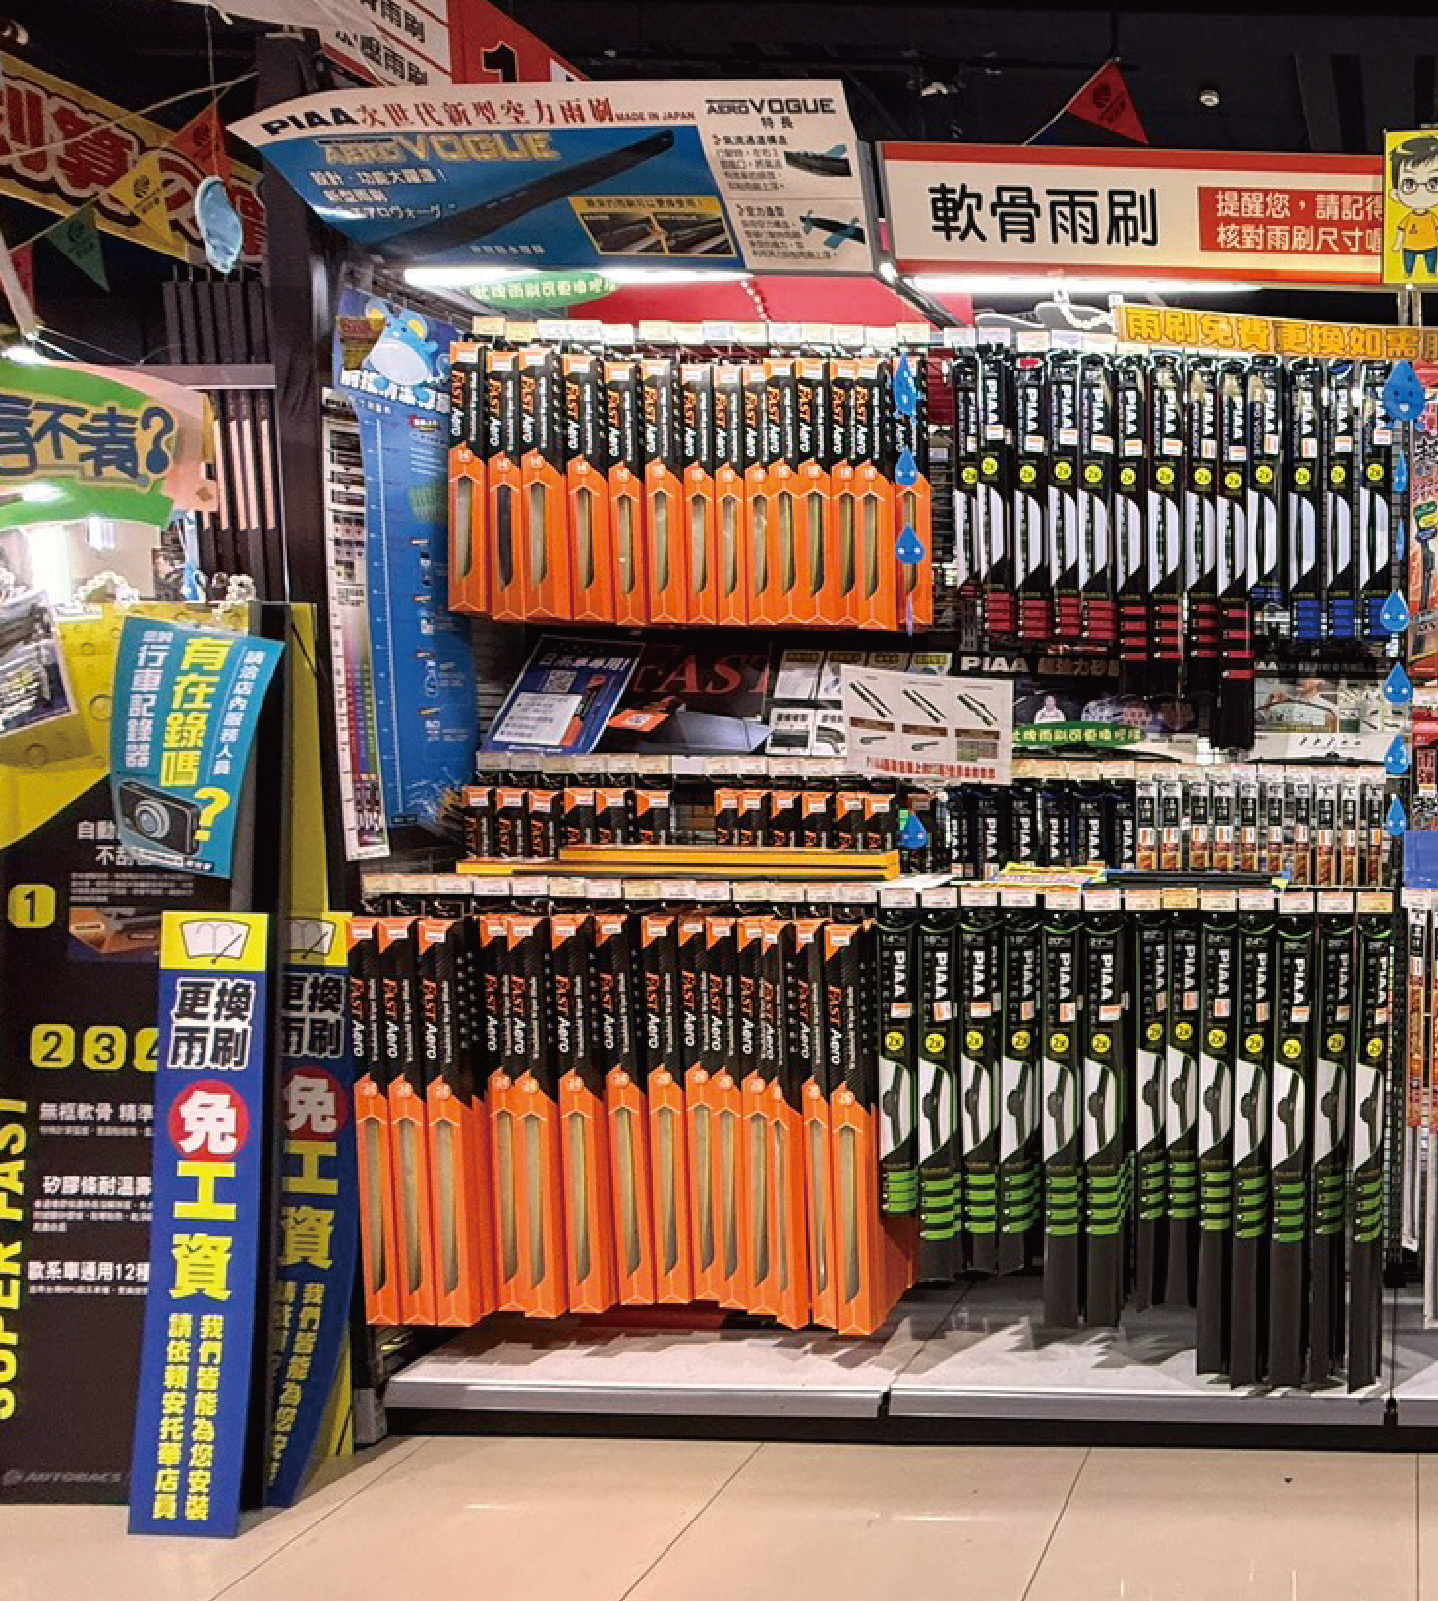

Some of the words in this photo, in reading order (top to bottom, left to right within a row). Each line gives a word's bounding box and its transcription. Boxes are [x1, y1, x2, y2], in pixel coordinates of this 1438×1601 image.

[261, 107, 359, 137] PIAA
[359, 96, 614, 128] 次世代新型空力雨刷
[616, 111, 648, 122] MADE
[649, 111, 660, 122] IN
[662, 110, 696, 122] JAPAN
[929, 183, 1159, 247] 軟骨雨刷
[986, 379, 998, 425] PIAA
[1028, 387, 1039, 433] PIAA
[1093, 389, 1103, 435] PIAA
[1165, 388, 1176, 433] PIAA
[1302, 388, 1314, 436] PIAA
[961, 656, 1030, 673] PIAA
[125, 645, 171, 768] 行車記錄器
[894, 950, 906, 997] PIAA
[935, 952, 948, 1000] PIAA
[973, 951, 985, 997] PIAA
[1060, 953, 1071, 999] PIAA
[1184, 945, 1195, 990] PIAA
[1218, 949, 1230, 995] PIAA
[1256, 953, 1268, 1000] PIAA
[1294, 958, 1306, 1004] PIAA
[173, 977, 257, 1023] 更換
[166, 1019, 254, 1071] 雨刷
[179, 1090, 239, 1155] 免
[285, 1074, 339, 1133] 免
[279, 1139, 340, 1269] 工資
[169, 1160, 238, 1301] 工資
[185, 1313, 225, 1521] 我們皆能為您安裝
